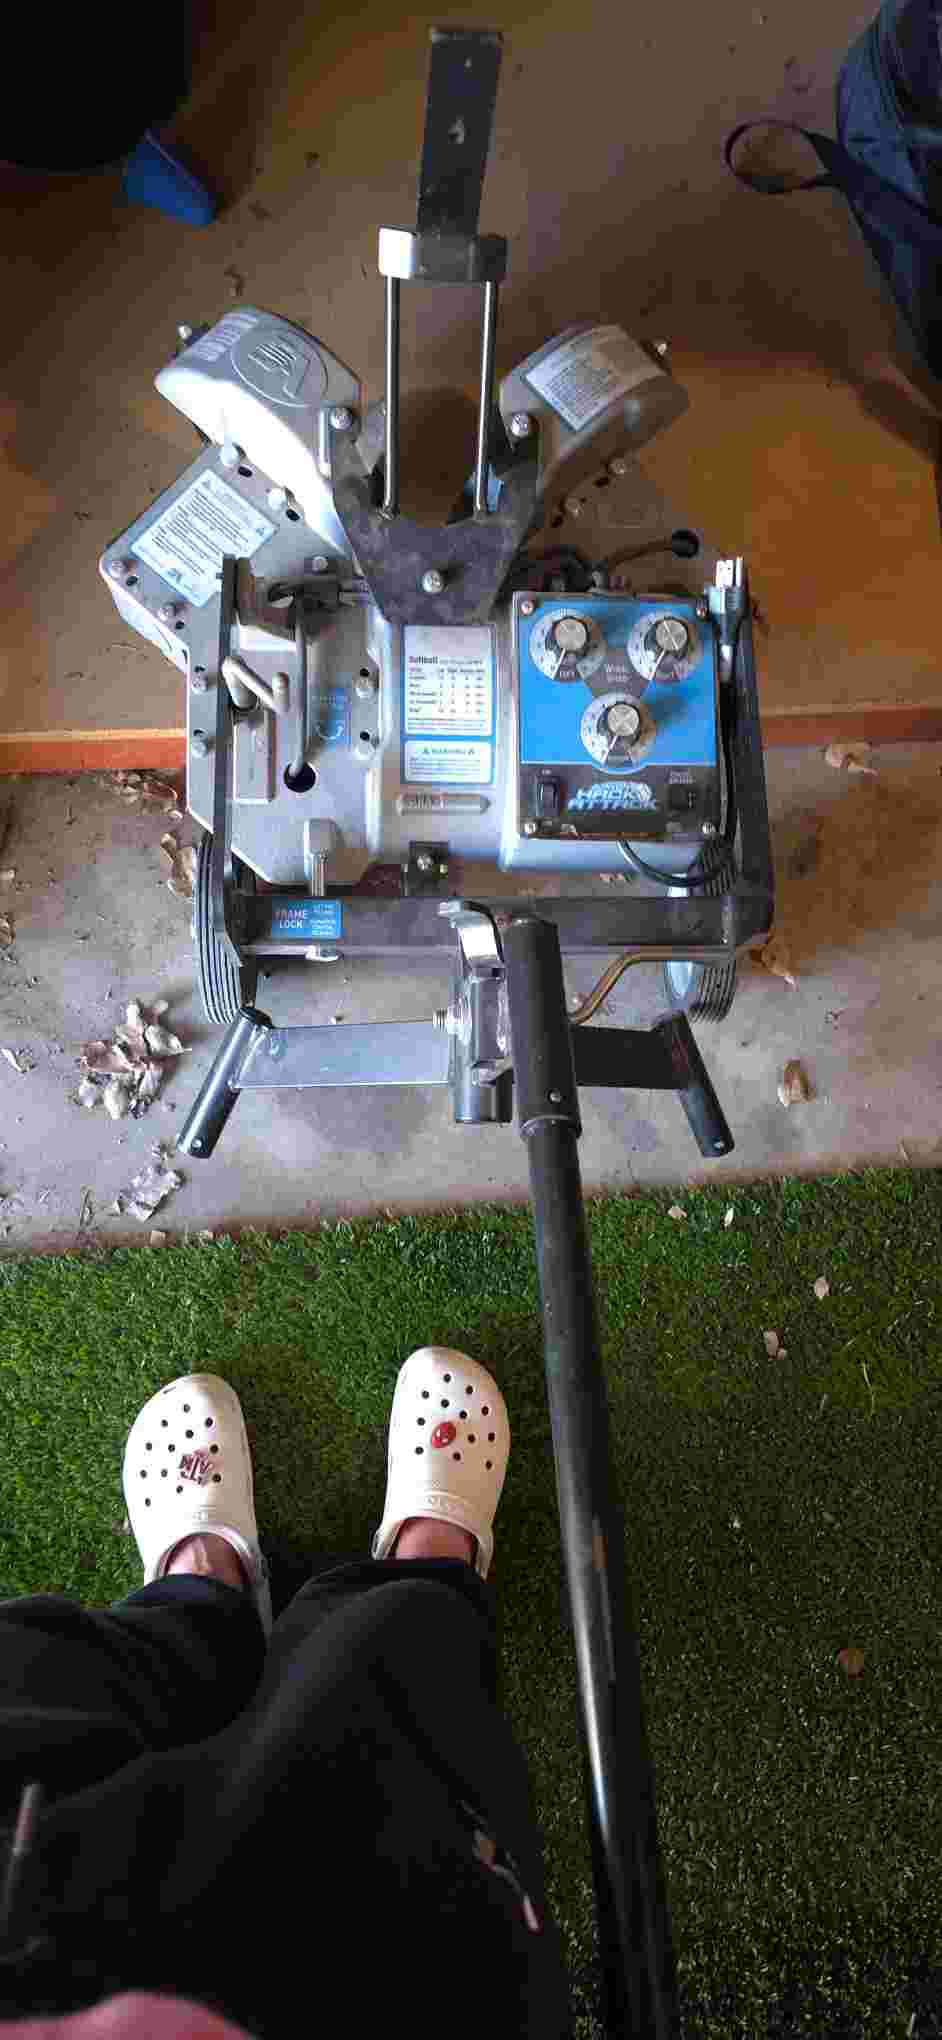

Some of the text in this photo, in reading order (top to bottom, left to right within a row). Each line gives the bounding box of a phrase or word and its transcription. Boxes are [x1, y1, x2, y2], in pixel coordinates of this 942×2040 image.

[575, 787, 636, 801] HACK
[567, 799, 657, 811] ATTACK
[275, 910, 309, 920] FRAME
[279, 919, 304, 929] LOCK
